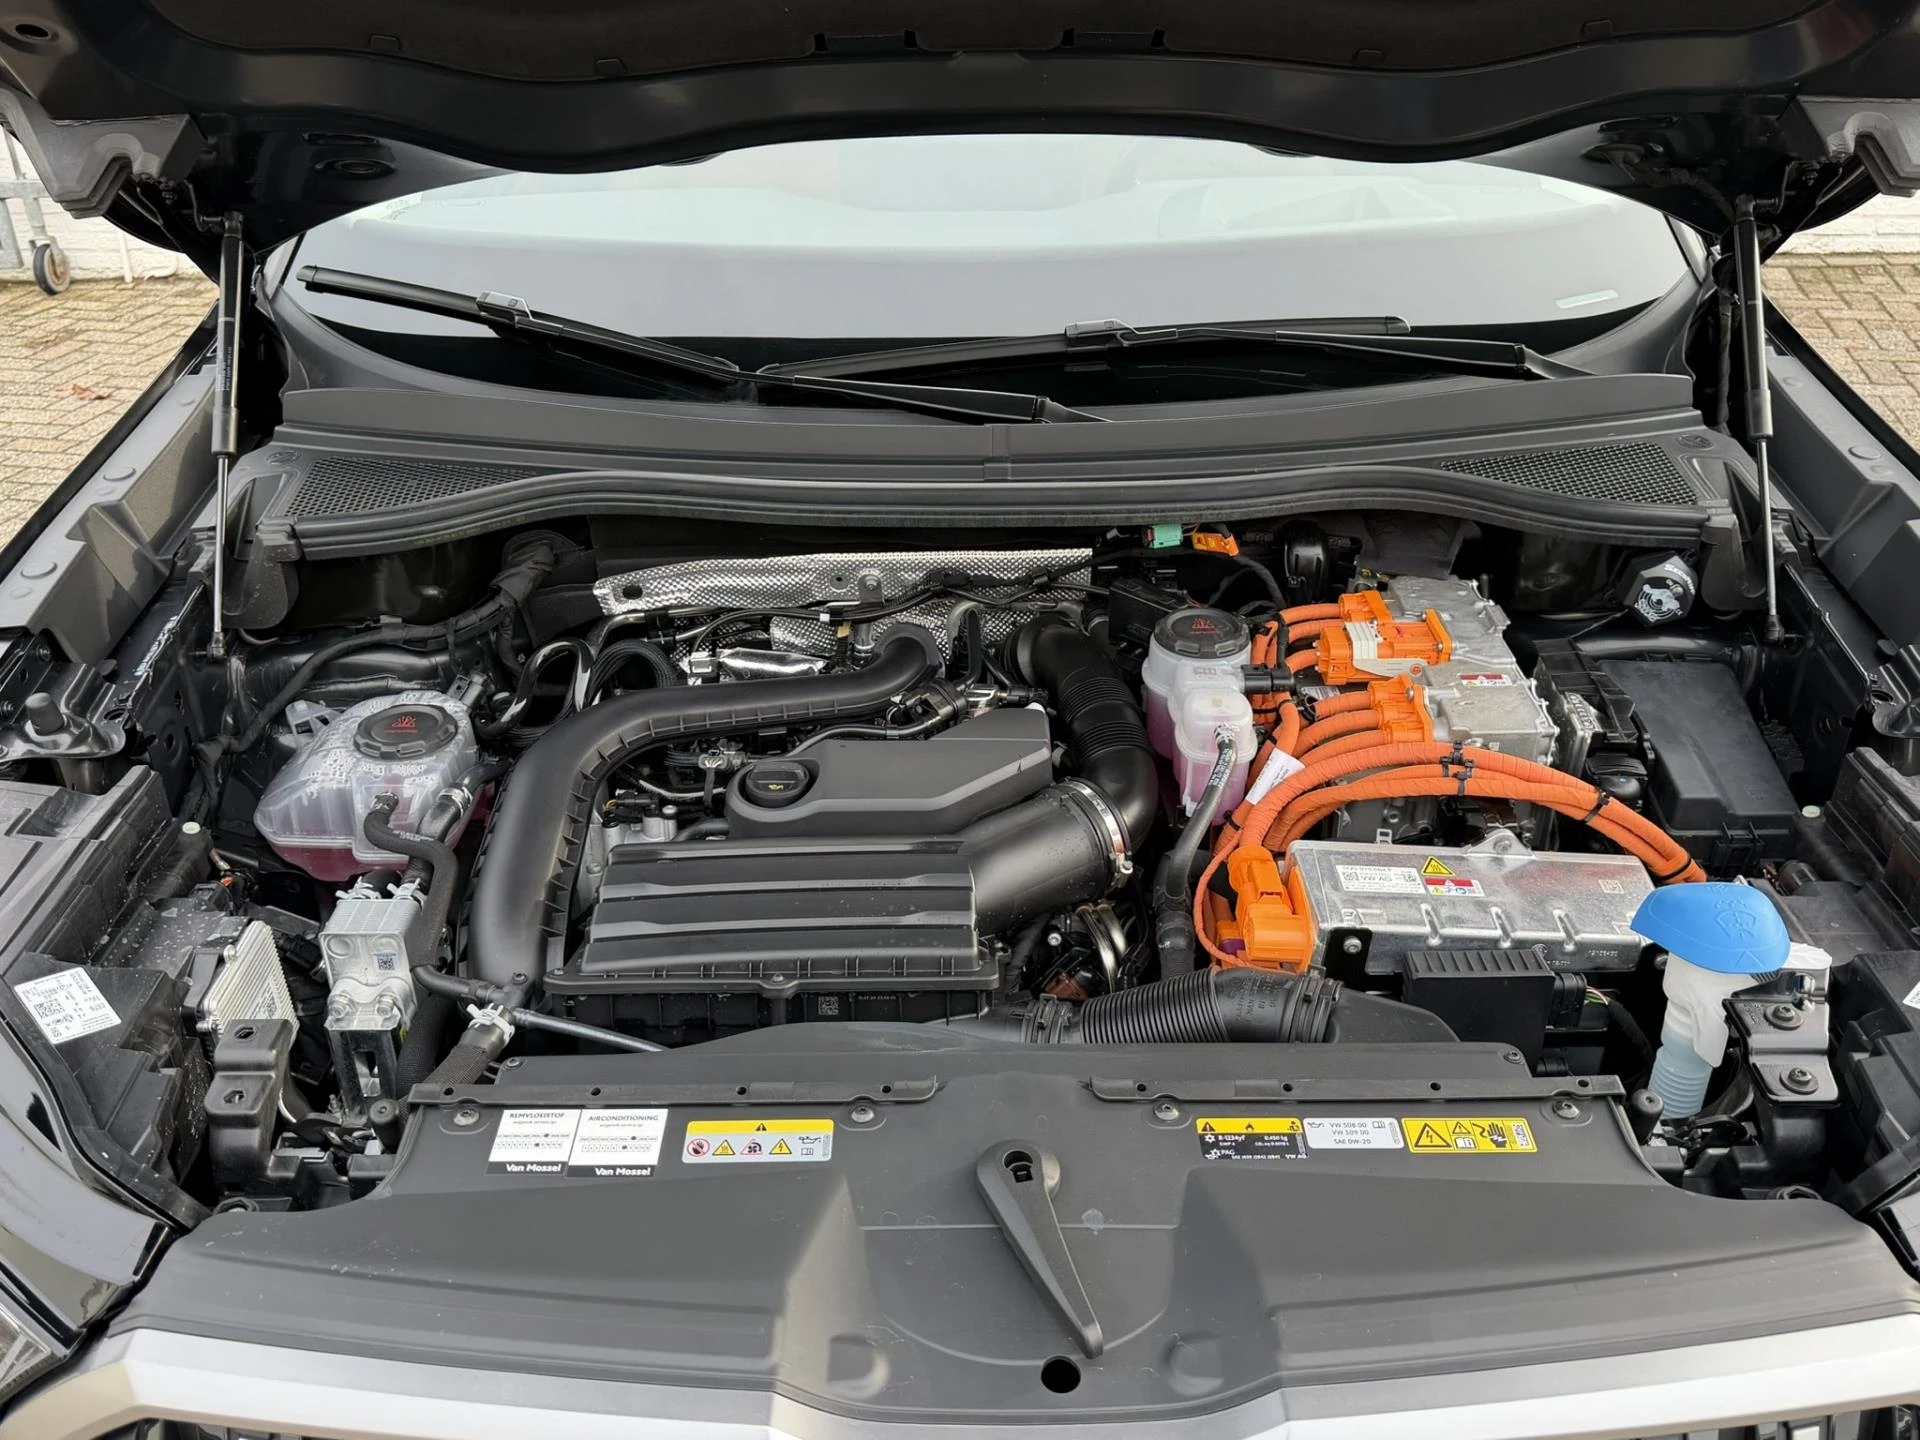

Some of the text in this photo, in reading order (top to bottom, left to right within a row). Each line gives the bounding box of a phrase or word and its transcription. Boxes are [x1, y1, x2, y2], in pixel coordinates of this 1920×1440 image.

[506, 1163, 562, 1172] Van Mossel
[594, 1167, 652, 1176] Van Mossel
